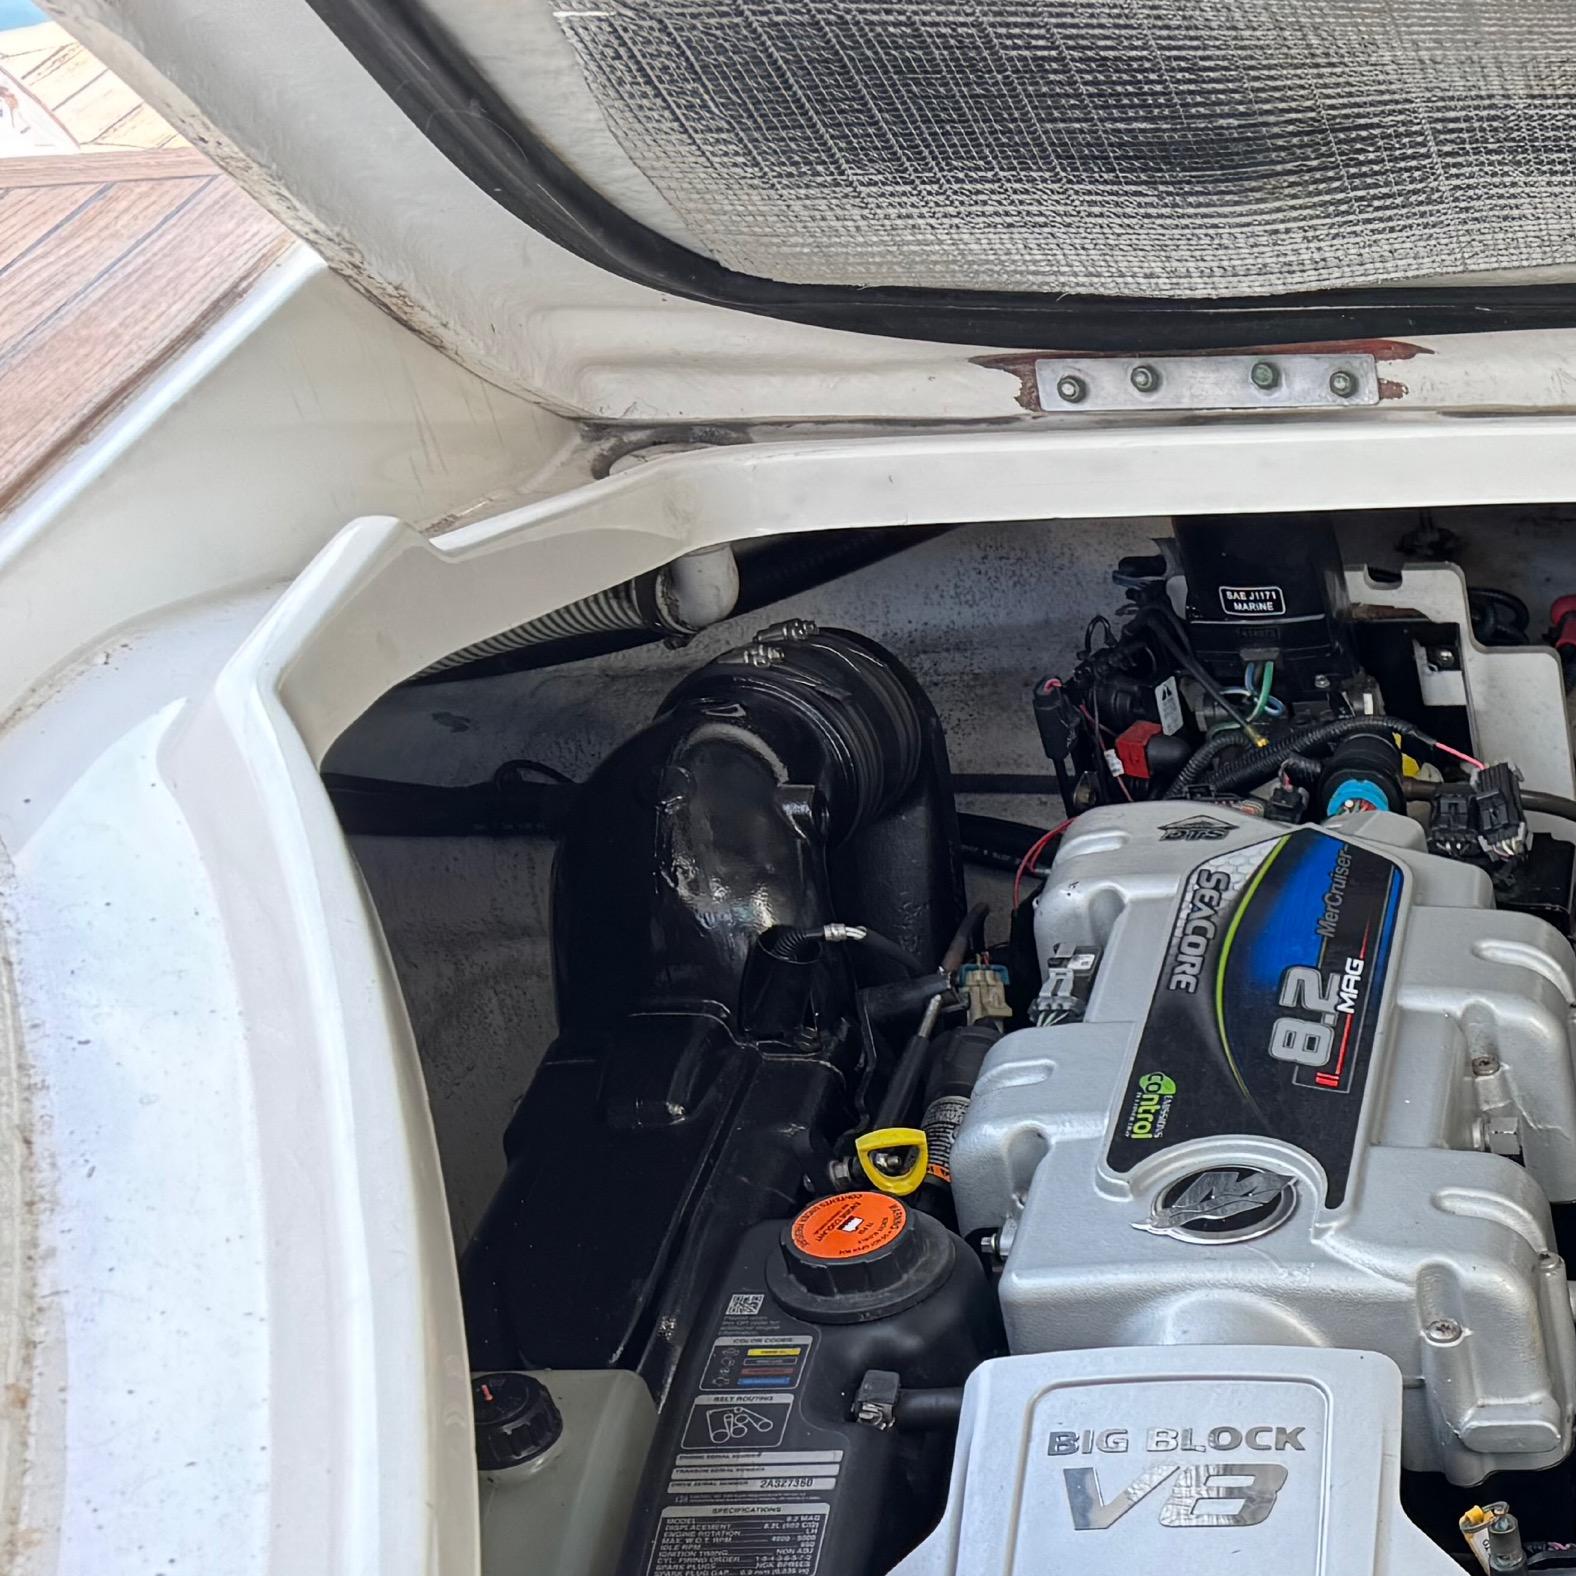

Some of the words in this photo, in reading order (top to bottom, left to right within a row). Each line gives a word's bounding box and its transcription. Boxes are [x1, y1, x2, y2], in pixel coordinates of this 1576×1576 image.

[1226, 591, 1246, 600] SAE
[1234, 602, 1274, 611] MARINE
[1316, 844, 1353, 938] MerCruiser
[1170, 868, 1231, 994] SEACORE
[1269, 965, 1342, 1067] 8.2
[1336, 957, 1365, 1014] MAG
[1131, 1073, 1163, 1138] control
[1048, 1429, 1128, 1456] BIG
[1147, 1426, 1306, 1452] BLOCK
[1063, 1463, 1288, 1530] V8
